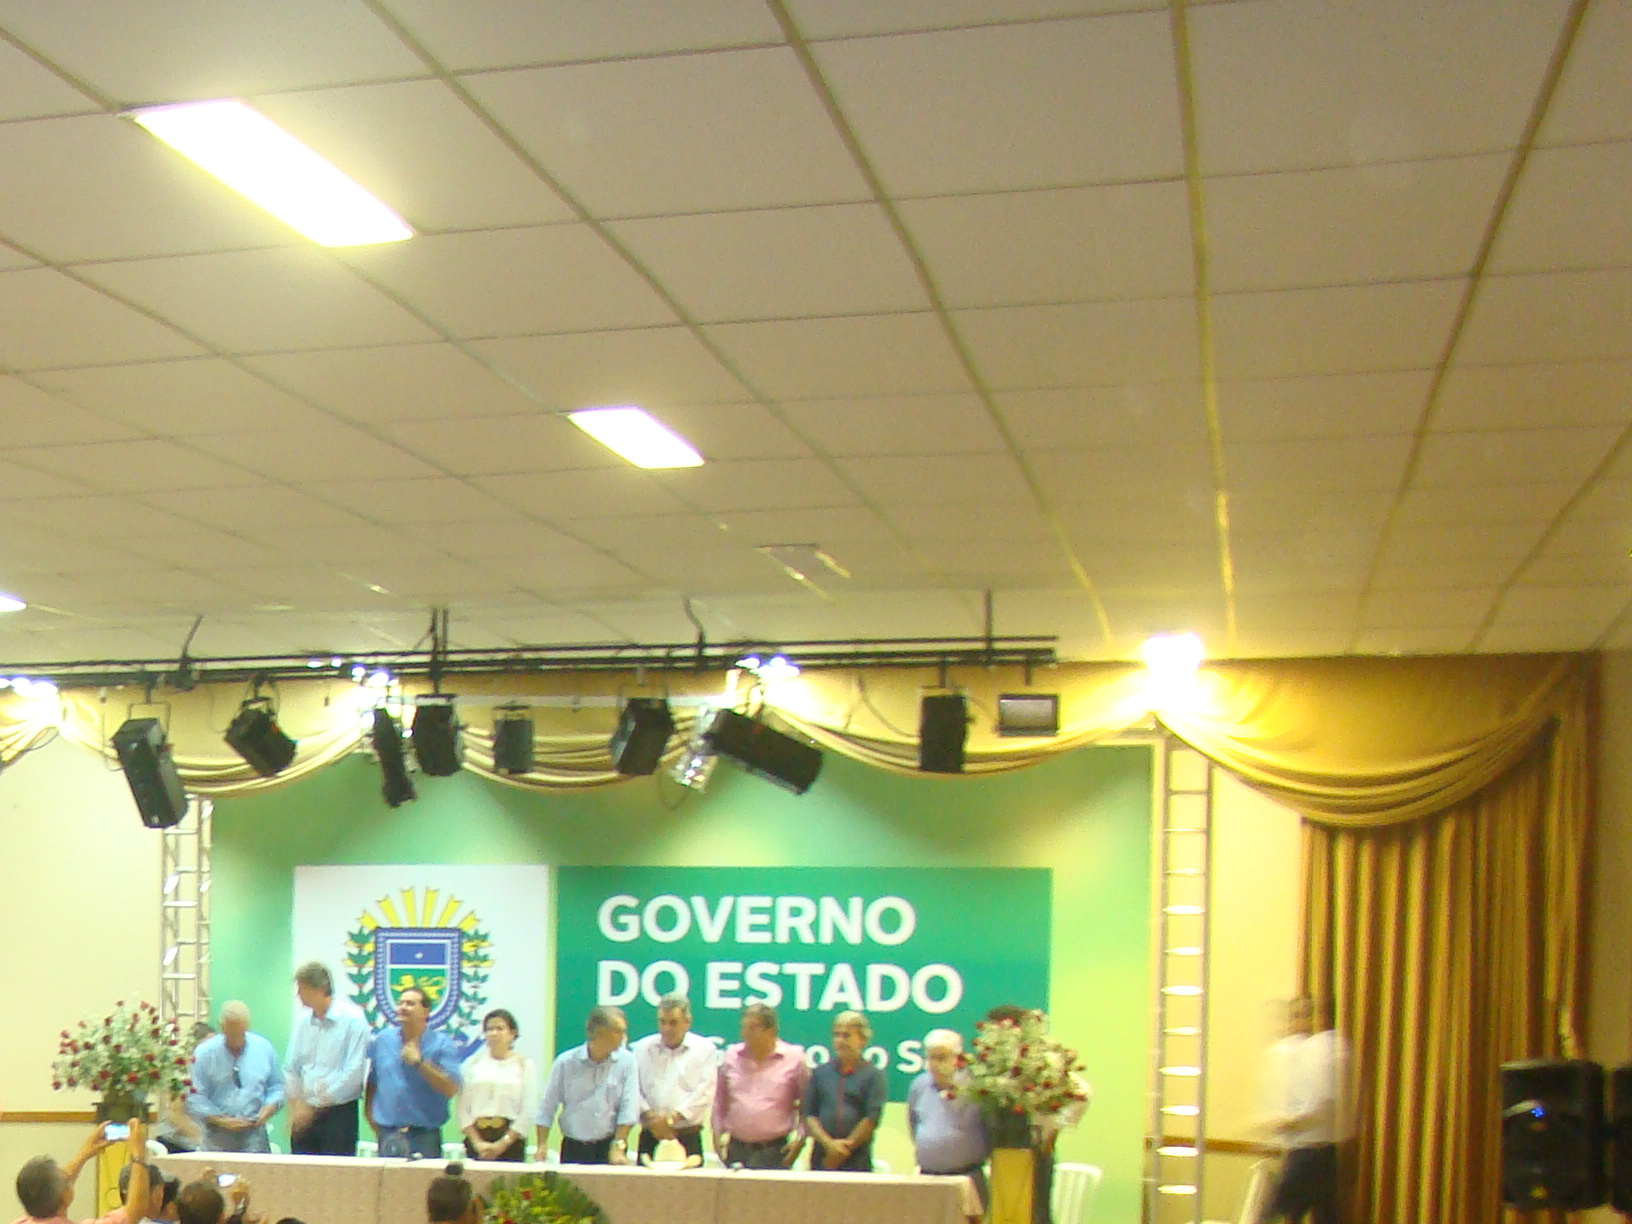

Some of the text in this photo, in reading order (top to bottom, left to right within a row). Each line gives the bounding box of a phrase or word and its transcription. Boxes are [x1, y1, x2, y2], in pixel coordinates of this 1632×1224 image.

[597, 894, 916, 946] GOVERNO
[597, 960, 964, 1014] DO ESTADO
